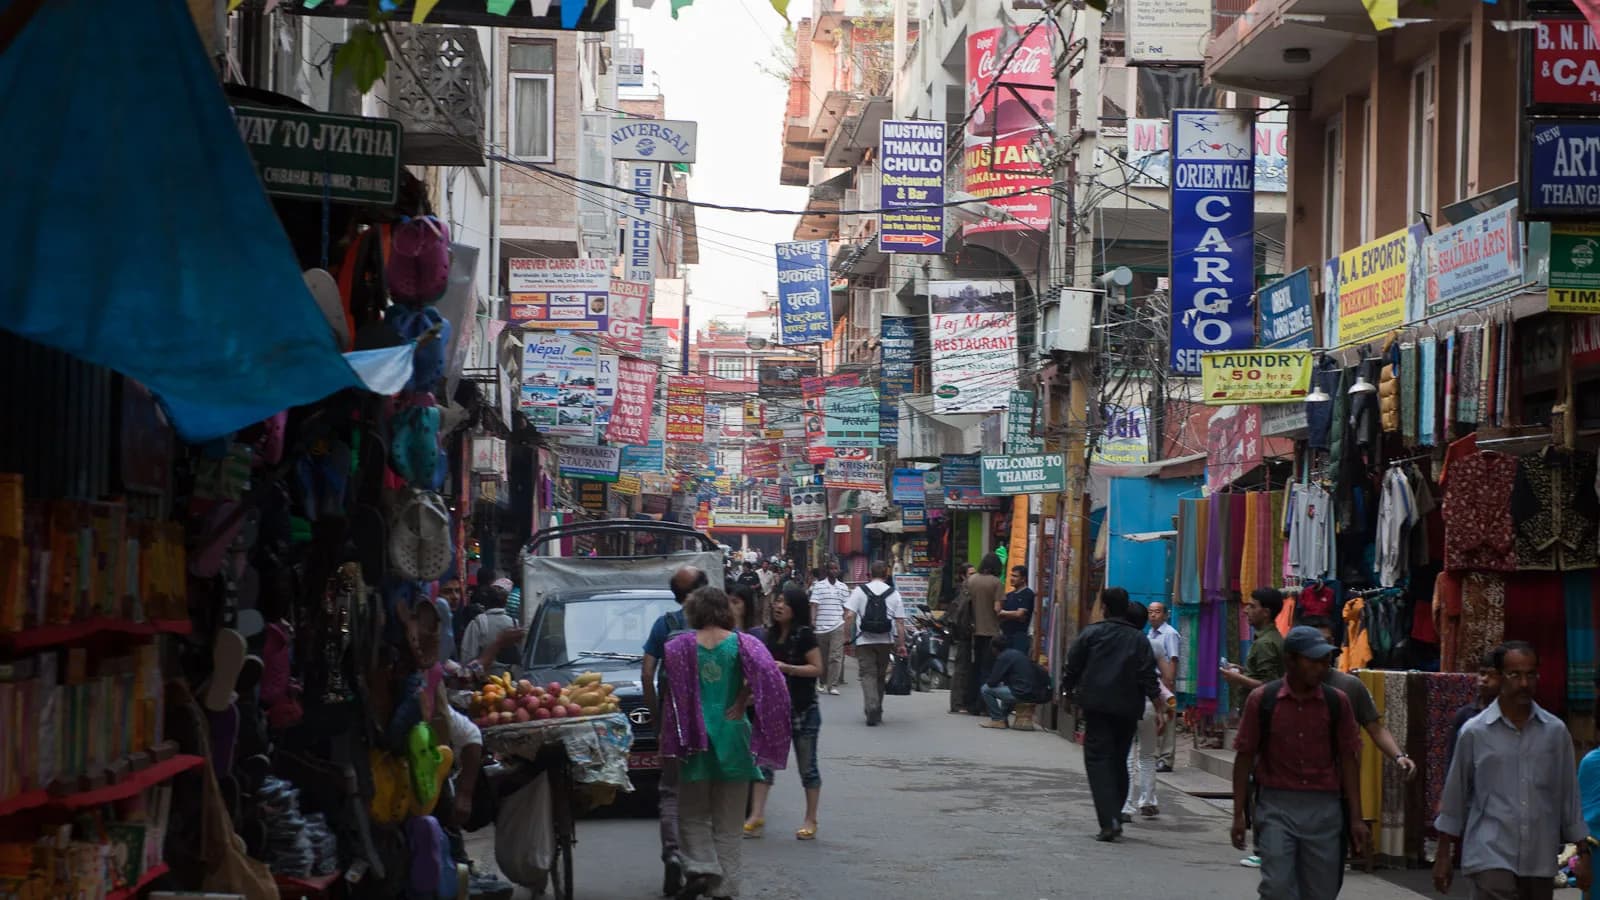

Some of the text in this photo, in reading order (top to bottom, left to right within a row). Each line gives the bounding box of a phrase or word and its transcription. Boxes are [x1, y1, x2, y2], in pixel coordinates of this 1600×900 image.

[281, 119, 310, 149] TO
[312, 123, 394, 157] JYATHA
[883, 124, 943, 140] MUSTANG
[1536, 125, 1561, 146] NEW
[884, 141, 942, 156] THAKALI
[965, 144, 1041, 169] MUSTAN
[884, 158, 943, 173] CHULO
[882, 174, 942, 187] Restaurant
[1175, 163, 1251, 190] ORIENTAL
[896, 187, 927, 200] & Bar
[1541, 184, 1600, 206] THANG
[632, 221, 651, 267] HOUSE
[1438, 227, 1506, 275] SHALIMAR ARTS
[511, 259, 547, 270] FOREVER
[548, 259, 577, 270] CARGO
[1362, 236, 1407, 277] EXPORTS
[1193, 195, 1233, 345] CARGO
[1339, 283, 1381, 318] TREKKING
[1382, 273, 1406, 306] SHOP
[934, 313, 1016, 335] Taj Mahal
[526, 343, 567, 359] Nepal
[934, 336, 1016, 351] RESTAURANT
[1211, 354, 1306, 369] LAUNDRY
[1231, 369, 1261, 381] 50
[668, 414, 703, 424] FAX
[984, 456, 1062, 470] WELCOME TO
[851, 470, 884, 479] CENTRE
[996, 469, 1046, 483] THAMEL
